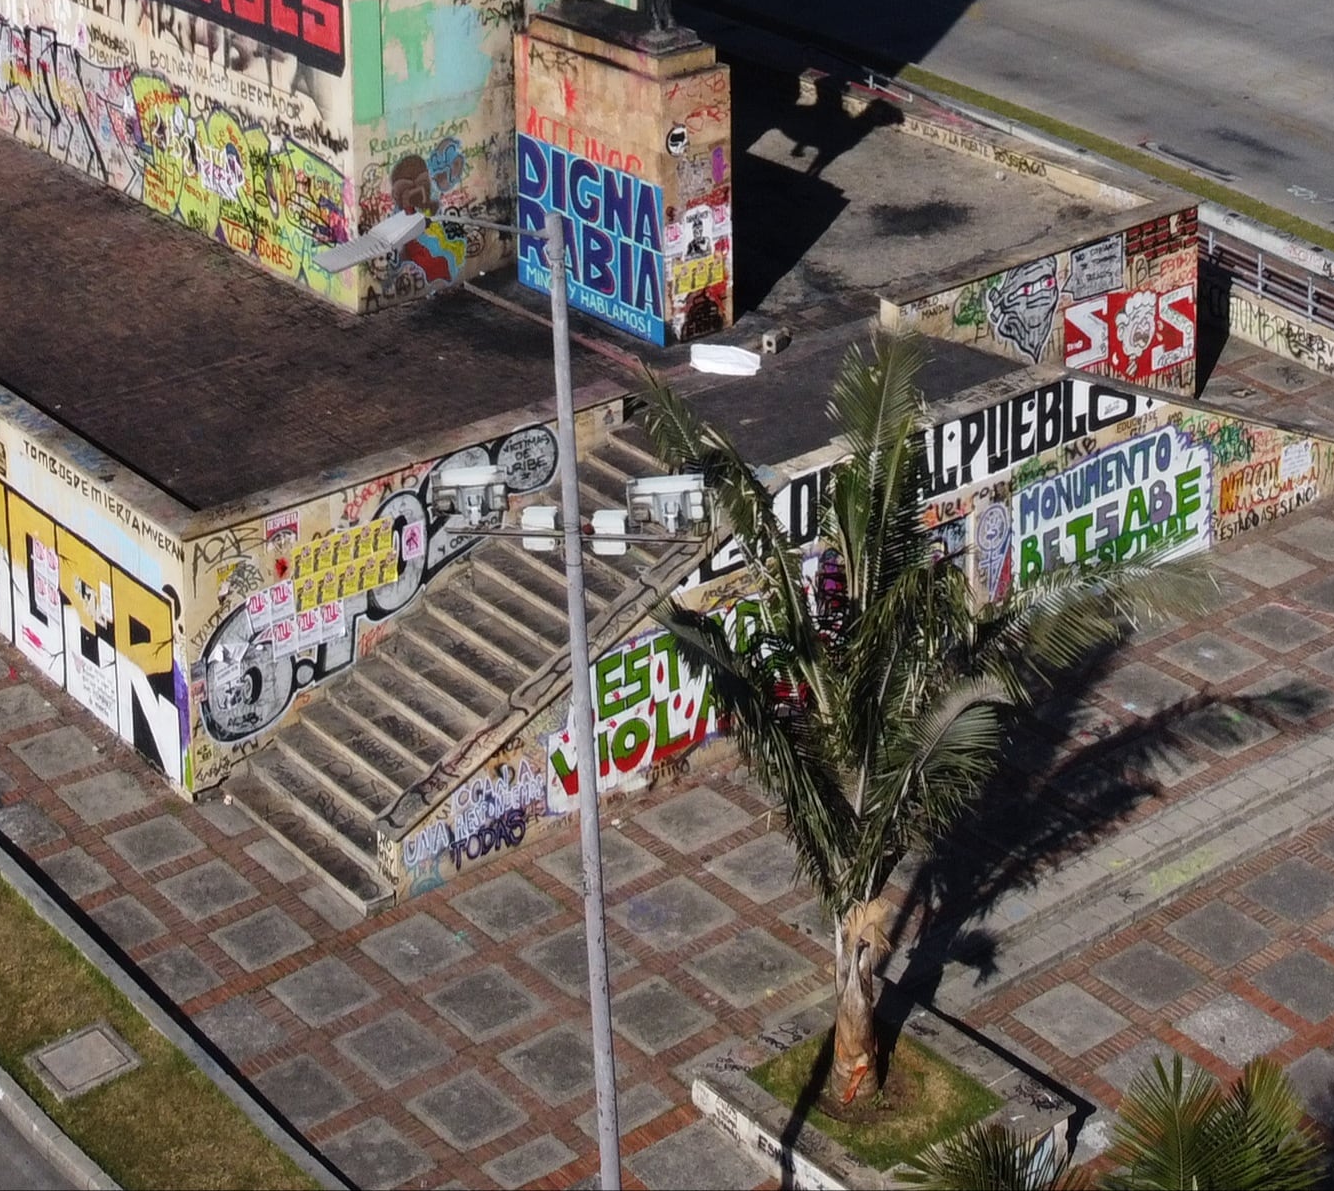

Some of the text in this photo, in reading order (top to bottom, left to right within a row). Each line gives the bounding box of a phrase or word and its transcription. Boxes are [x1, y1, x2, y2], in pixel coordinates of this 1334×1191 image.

[517, 134, 663, 254] DIGNA
[961, 381, 1137, 487] PUEBLO
[1019, 432, 1172, 536] MONUMENTO
[450, 808, 527, 872] TODAS
